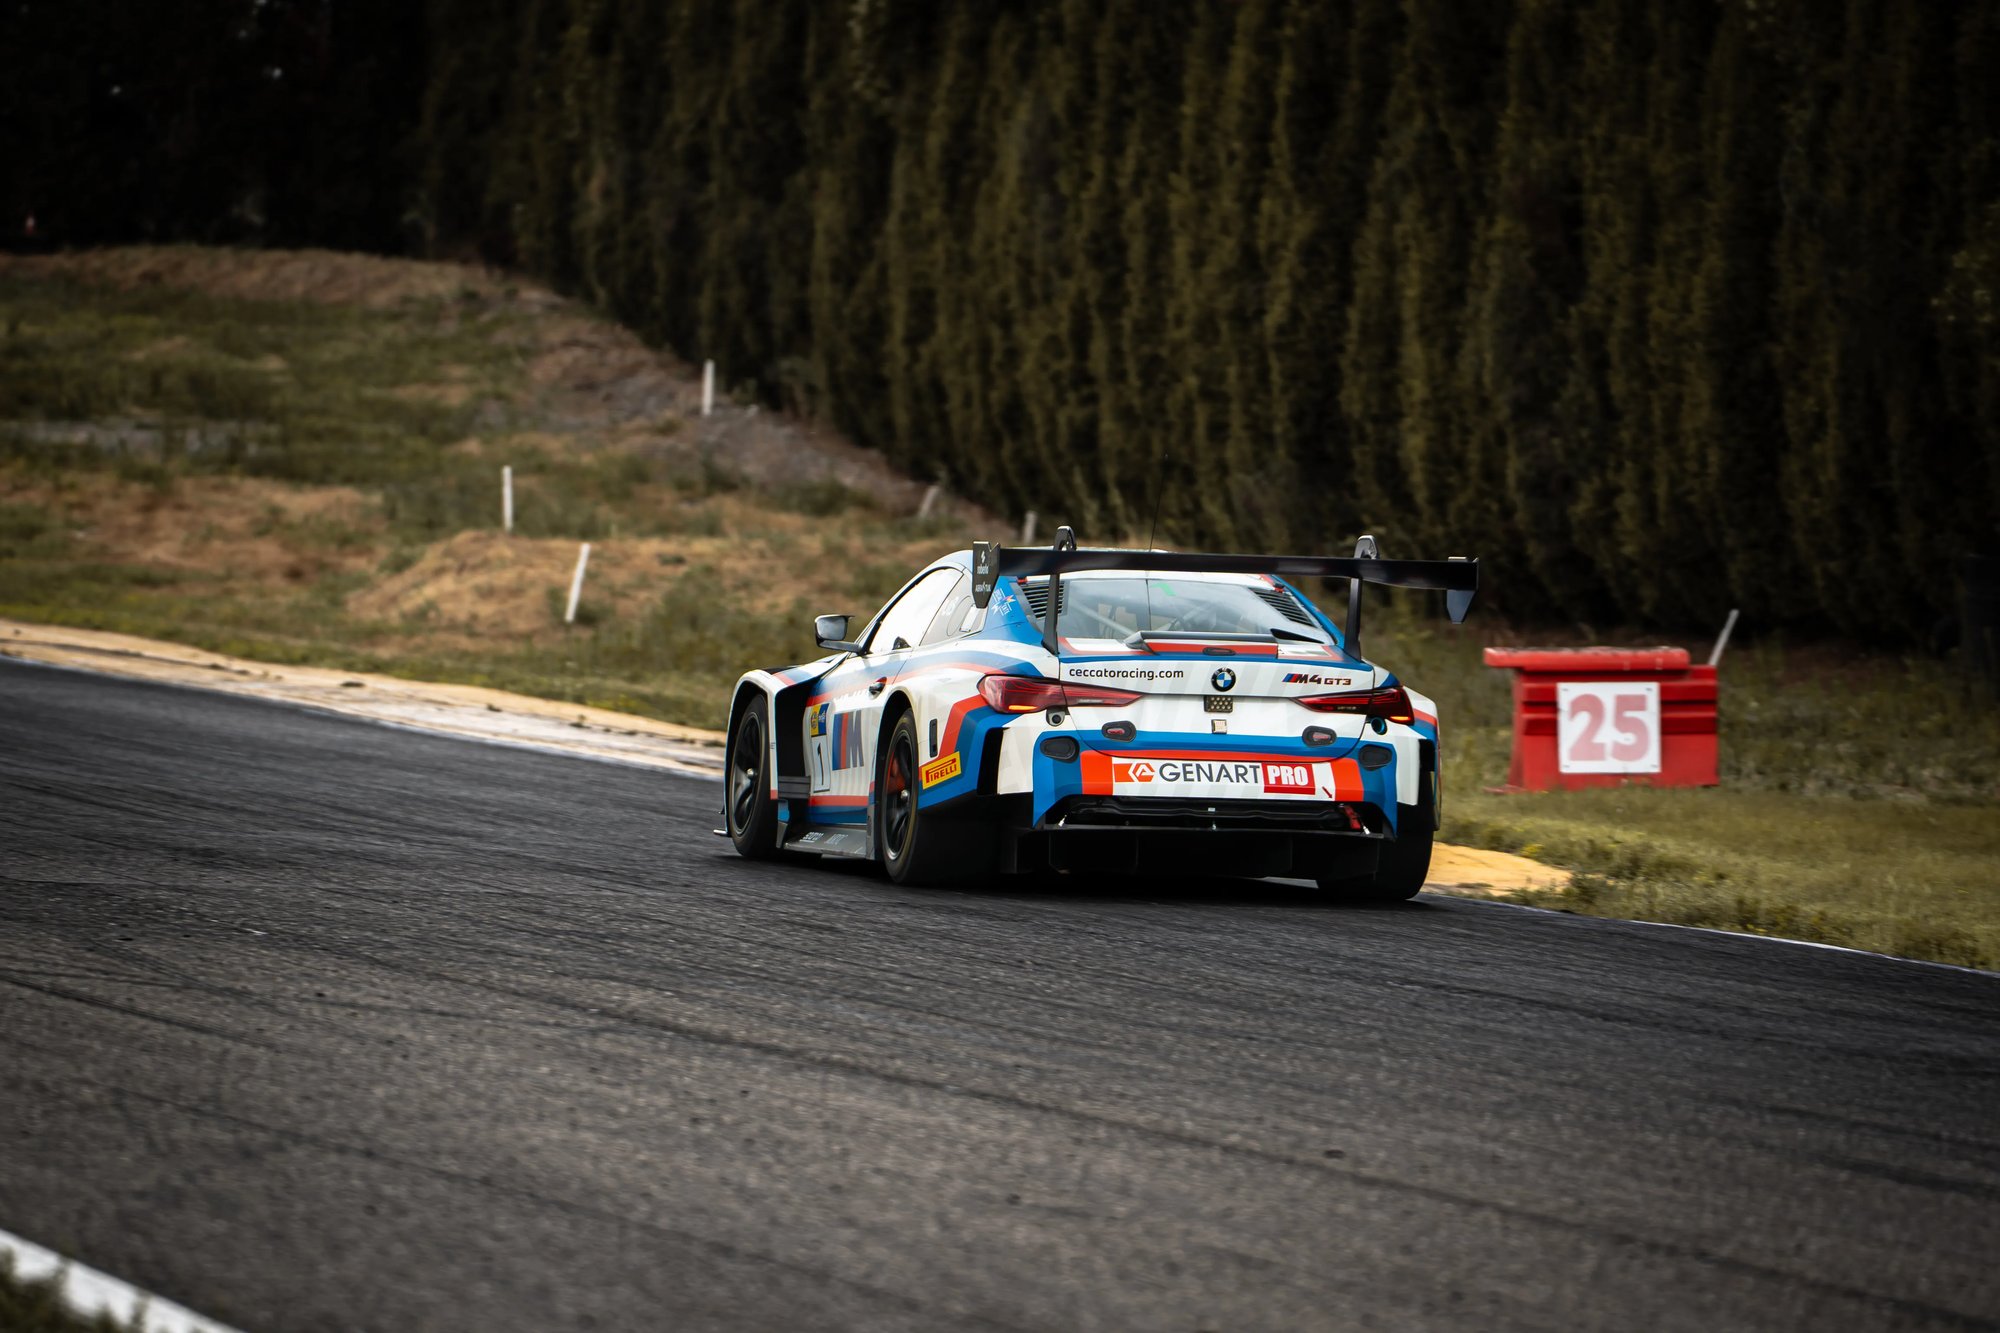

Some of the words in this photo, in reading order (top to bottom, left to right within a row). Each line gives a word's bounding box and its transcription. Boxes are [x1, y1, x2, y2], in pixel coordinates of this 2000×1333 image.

[1069, 668, 1184, 680] ceccatoracing.com
[1294, 673, 1322, 685] M4
[1324, 677, 1352, 686] GT3
[845, 710, 865, 769] M
[1568, 694, 1650, 762] 25
[816, 742, 825, 786] 1
[925, 757, 957, 784] PIRELLI
[1158, 762, 1261, 784] GENART
[1266, 764, 1309, 786] PRO
